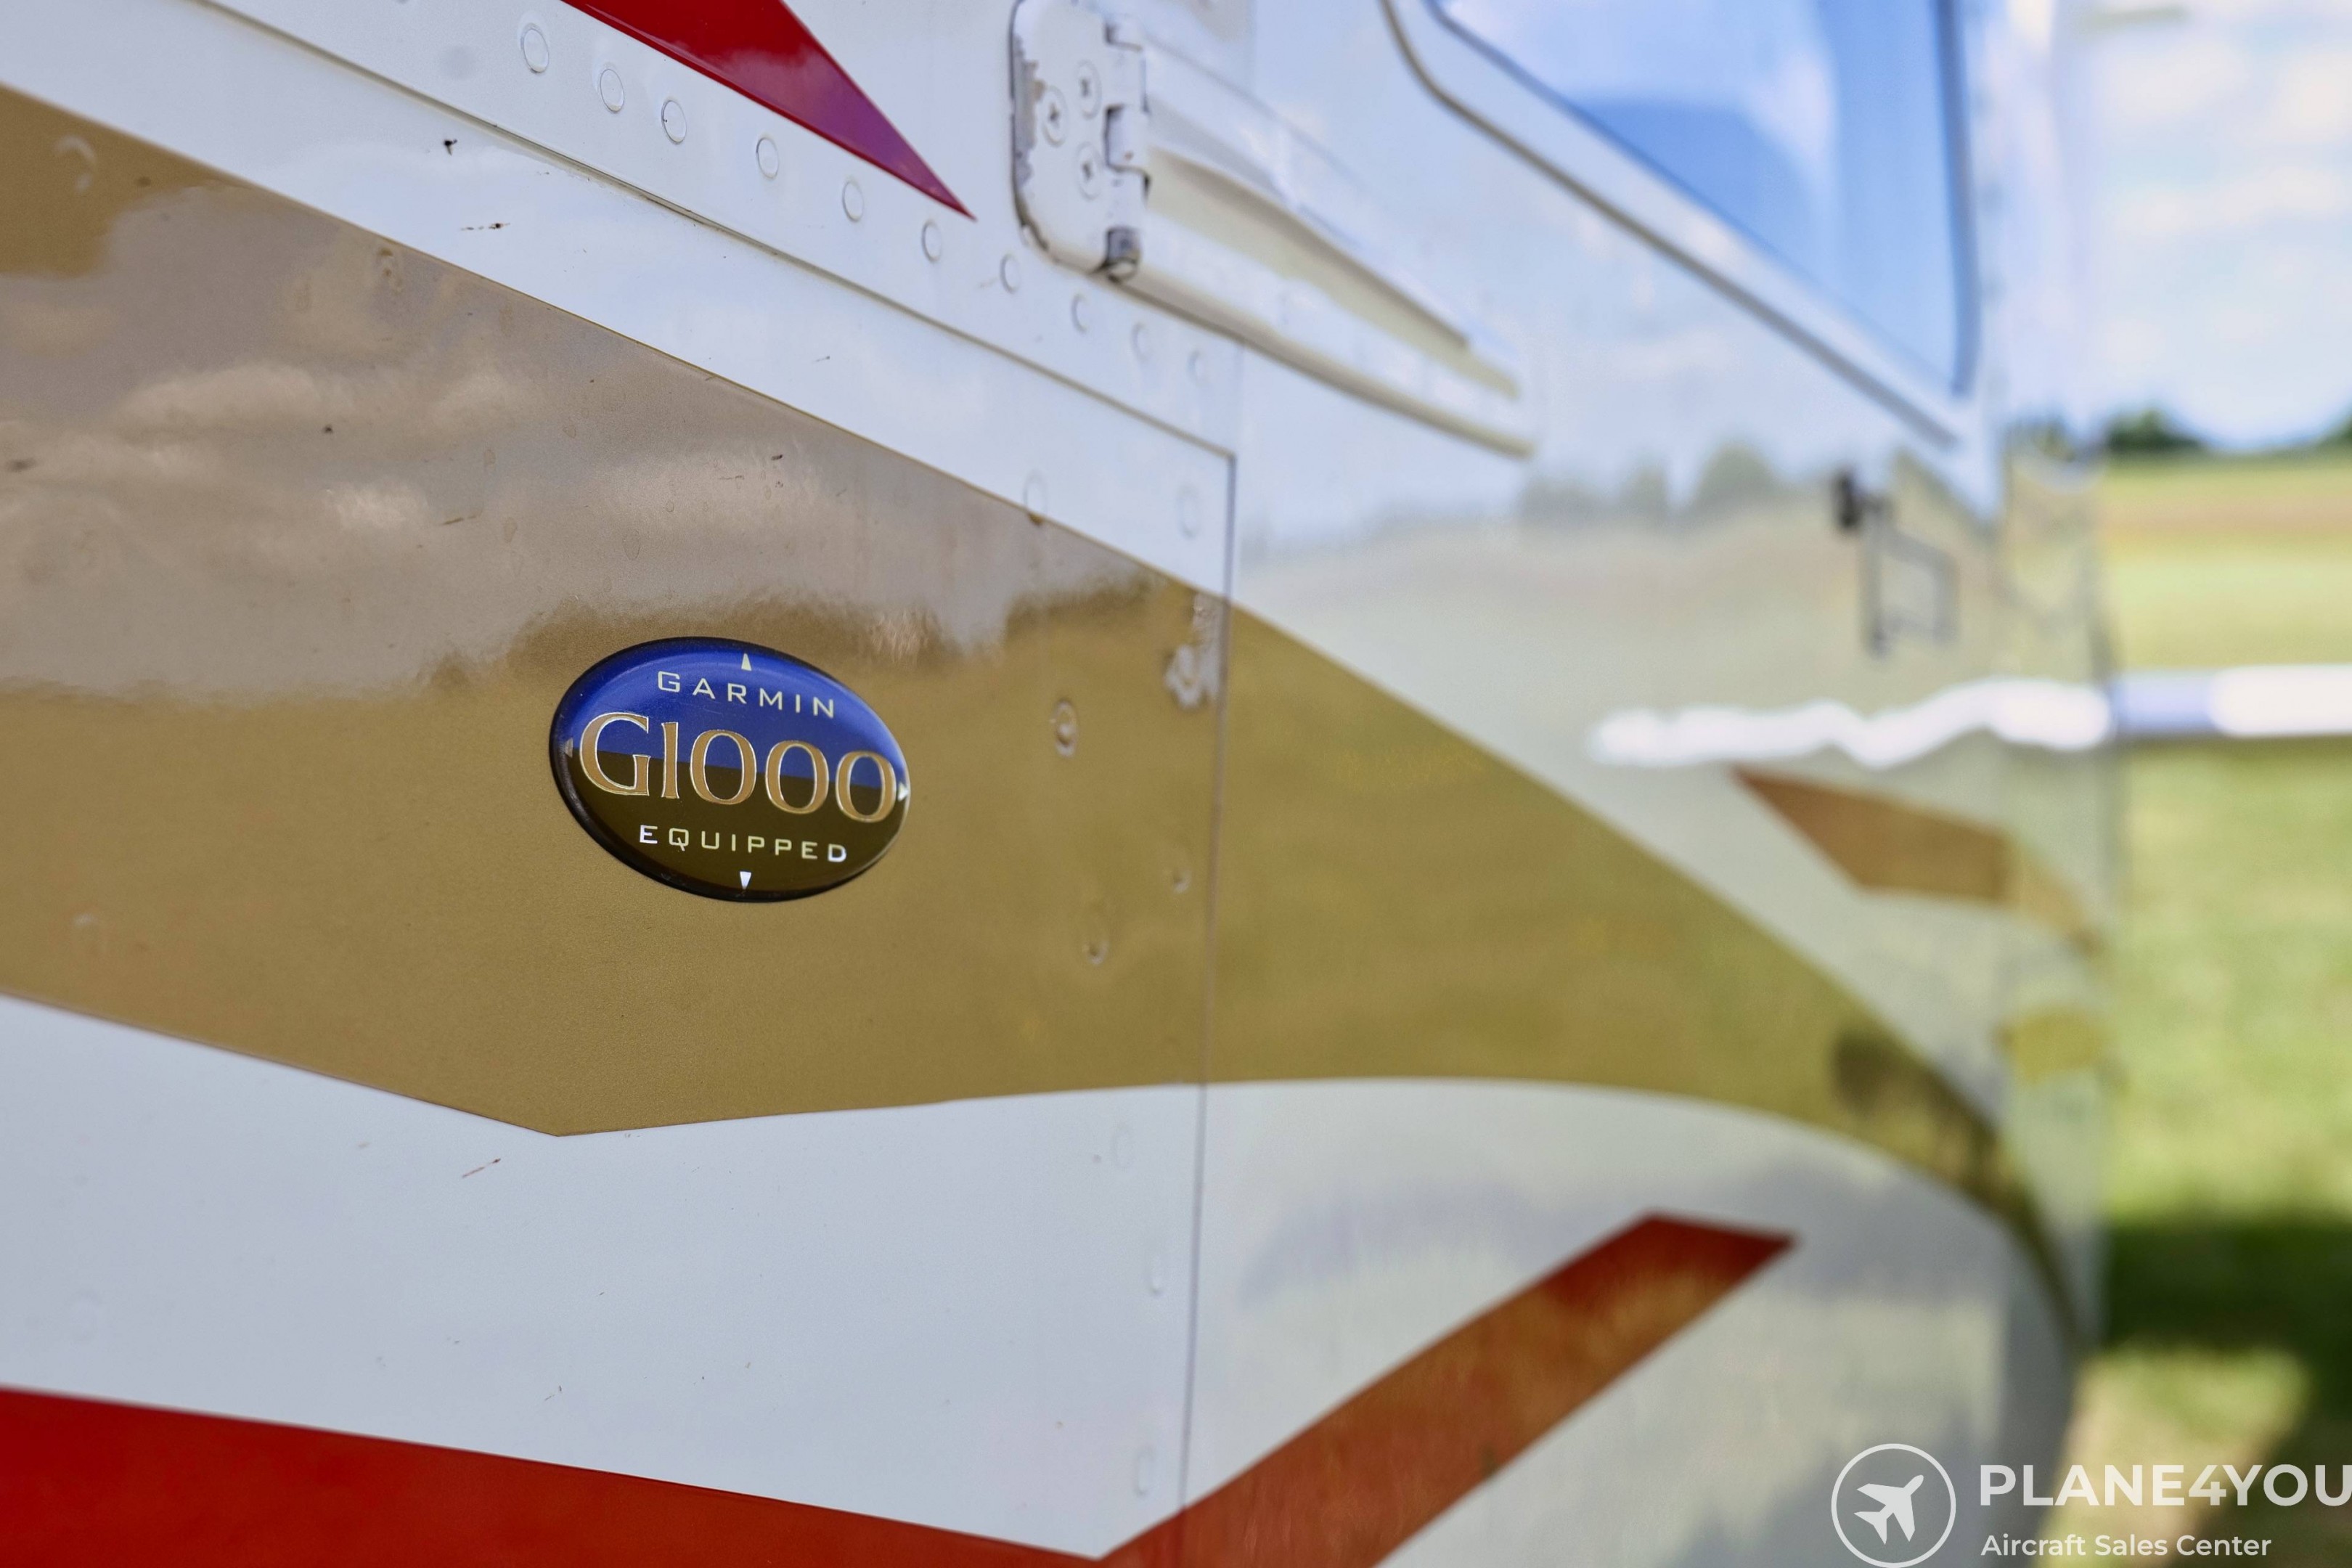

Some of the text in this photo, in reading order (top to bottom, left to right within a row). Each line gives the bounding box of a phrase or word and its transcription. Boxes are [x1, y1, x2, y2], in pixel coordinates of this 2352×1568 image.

[658, 670, 836, 719] GARMIN
[579, 711, 897, 823] G1000
[639, 825, 847, 863] EQUIPPED
